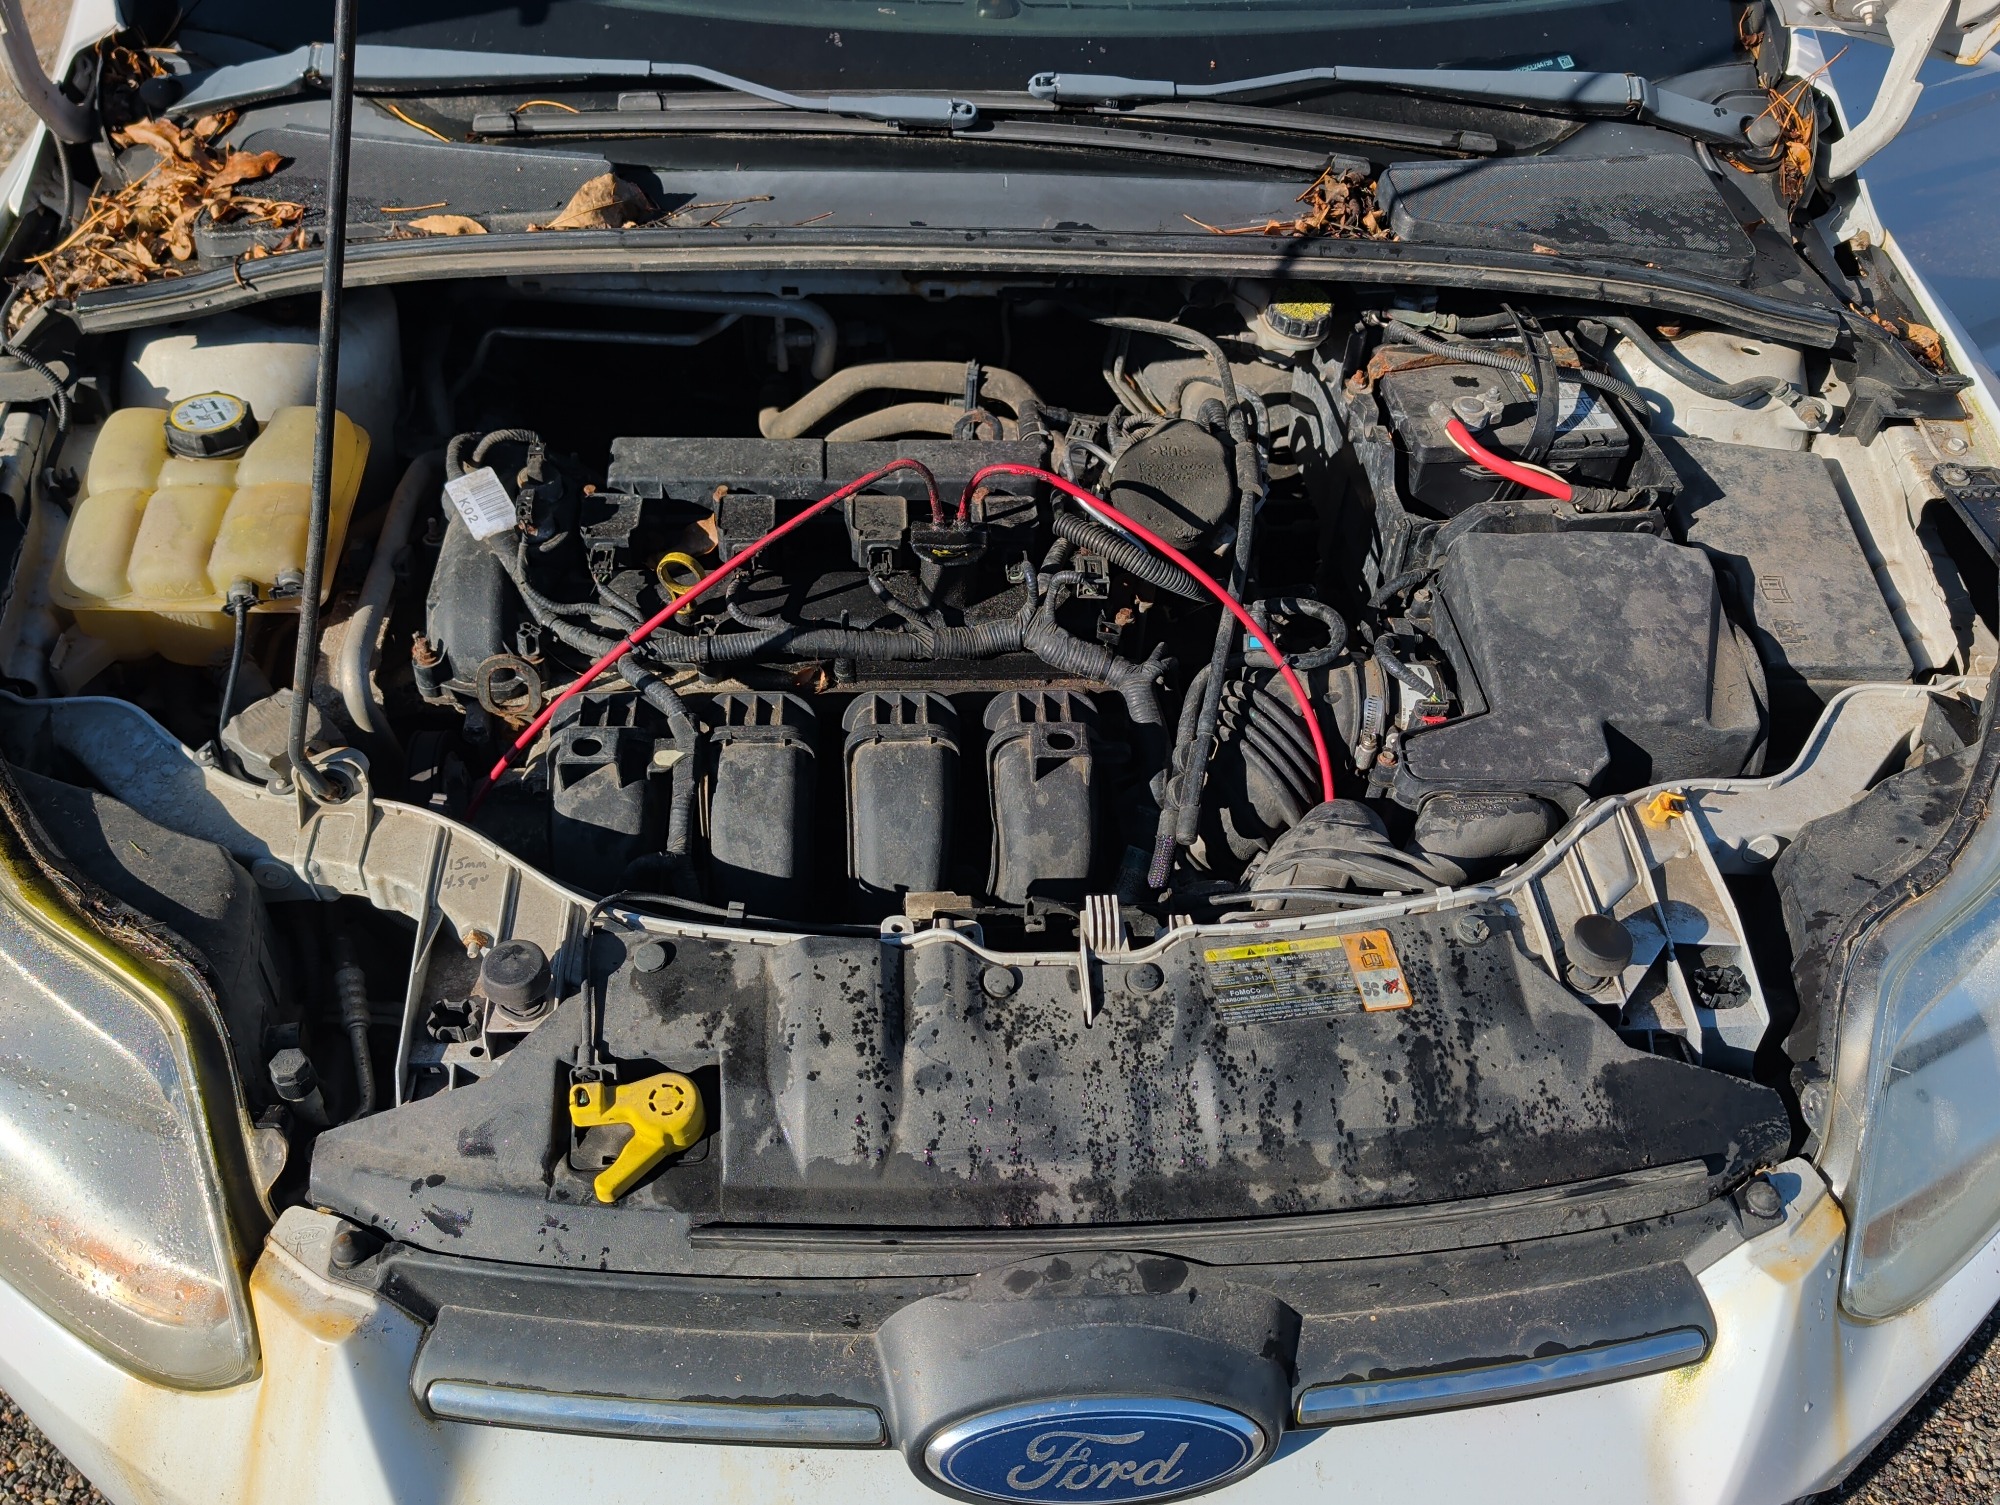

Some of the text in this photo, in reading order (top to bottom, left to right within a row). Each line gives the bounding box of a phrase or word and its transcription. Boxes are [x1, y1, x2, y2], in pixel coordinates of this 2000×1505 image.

[459, 496, 479, 524] K02
[449, 856, 487, 870] 15mm
[1229, 988, 1261, 997] FoMoCo
[1007, 1431, 1189, 1491] Ford
